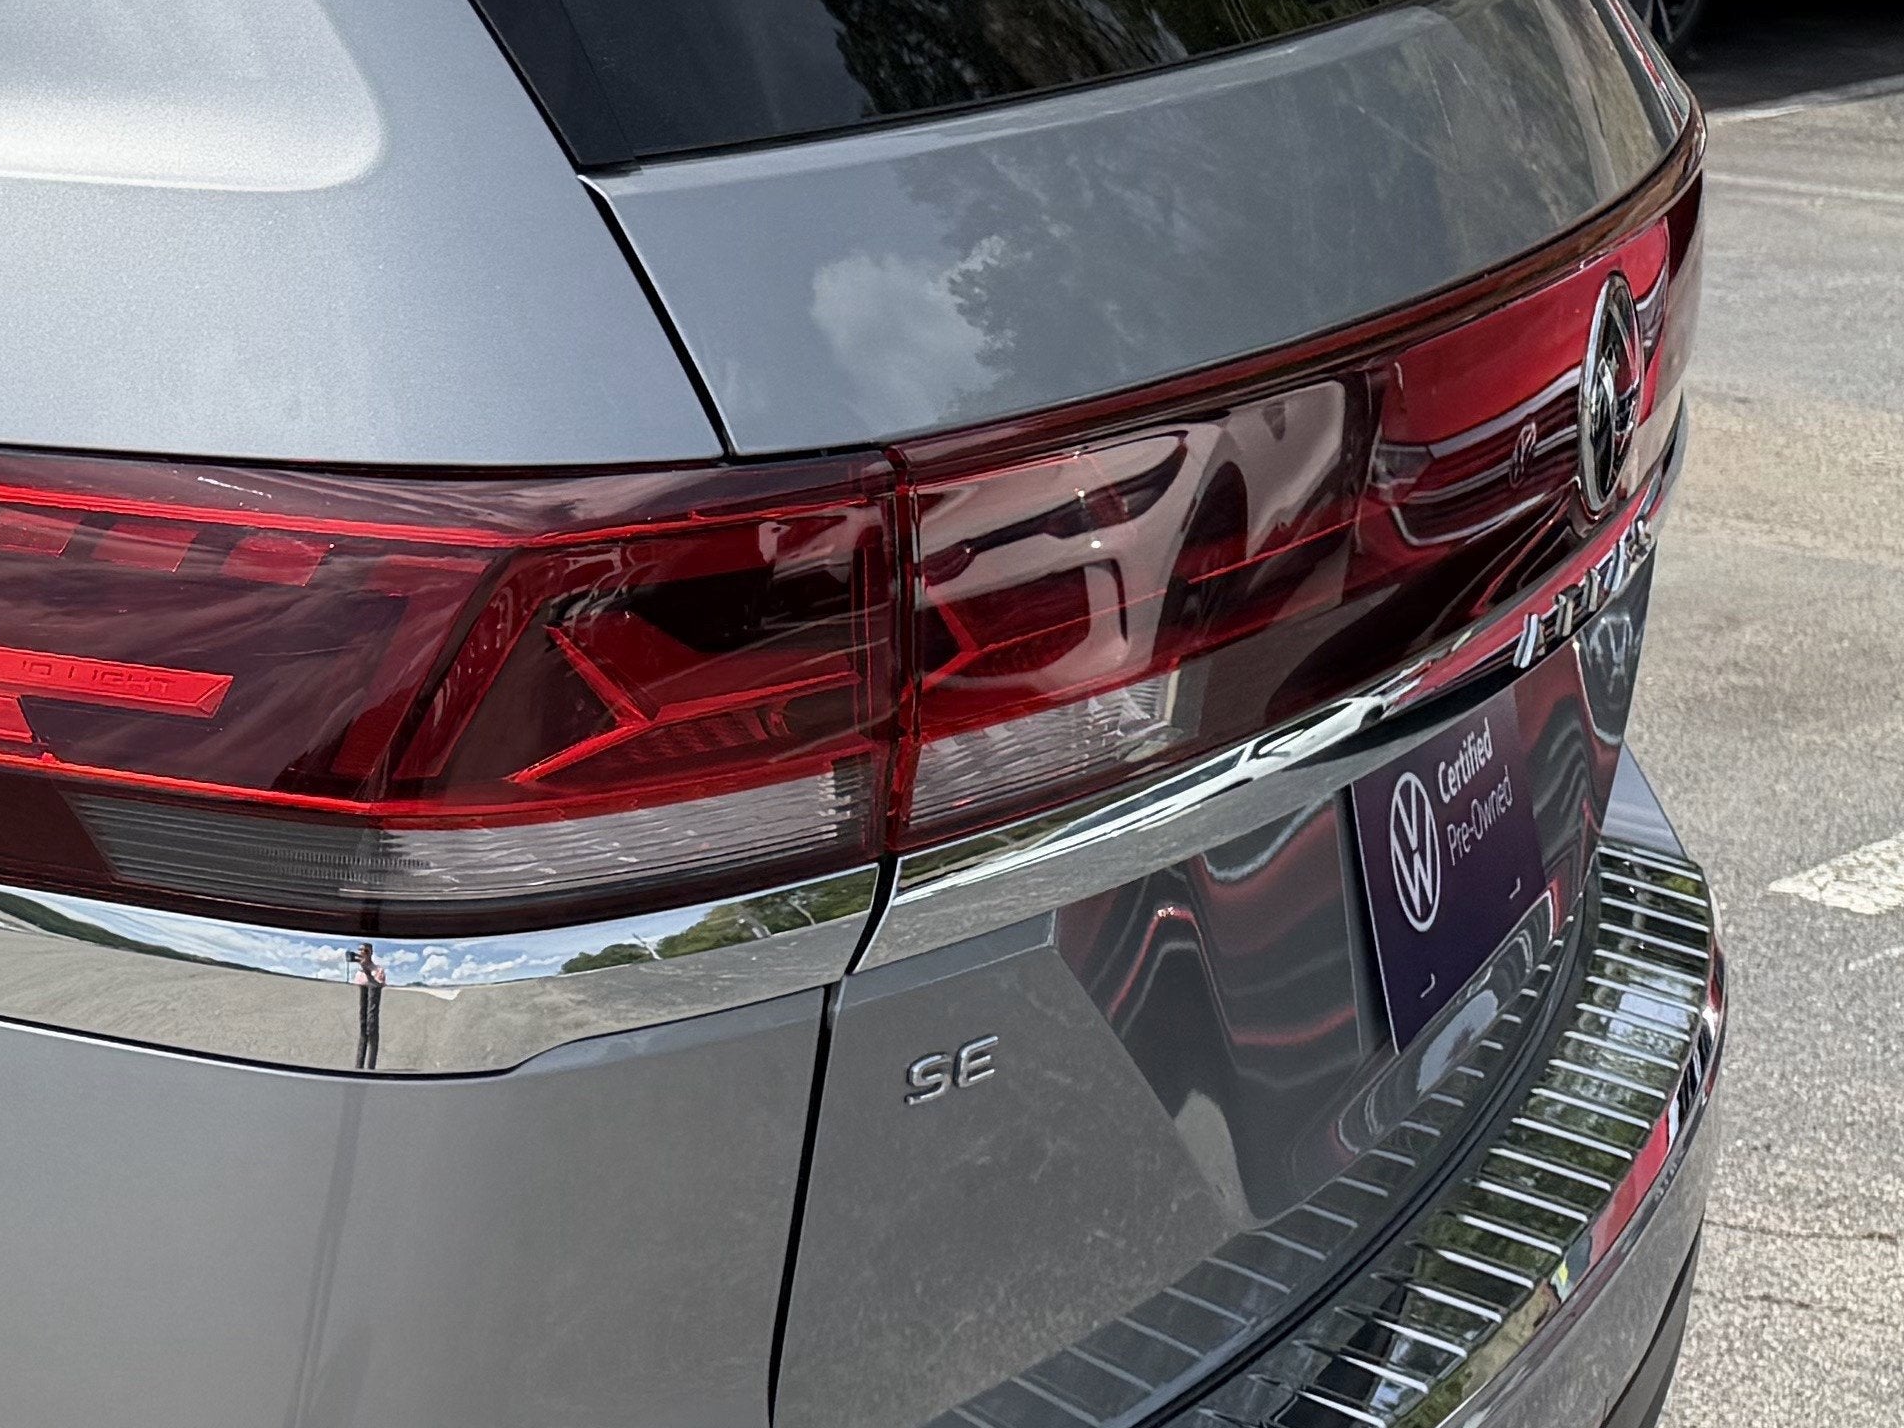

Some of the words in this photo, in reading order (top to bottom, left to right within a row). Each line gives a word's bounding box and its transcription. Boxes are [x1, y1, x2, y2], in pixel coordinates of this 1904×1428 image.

[1438, 717, 1493, 804] Certified
[1447, 765, 1513, 866] Pre-Owned
[905, 1034, 998, 1105] SE
